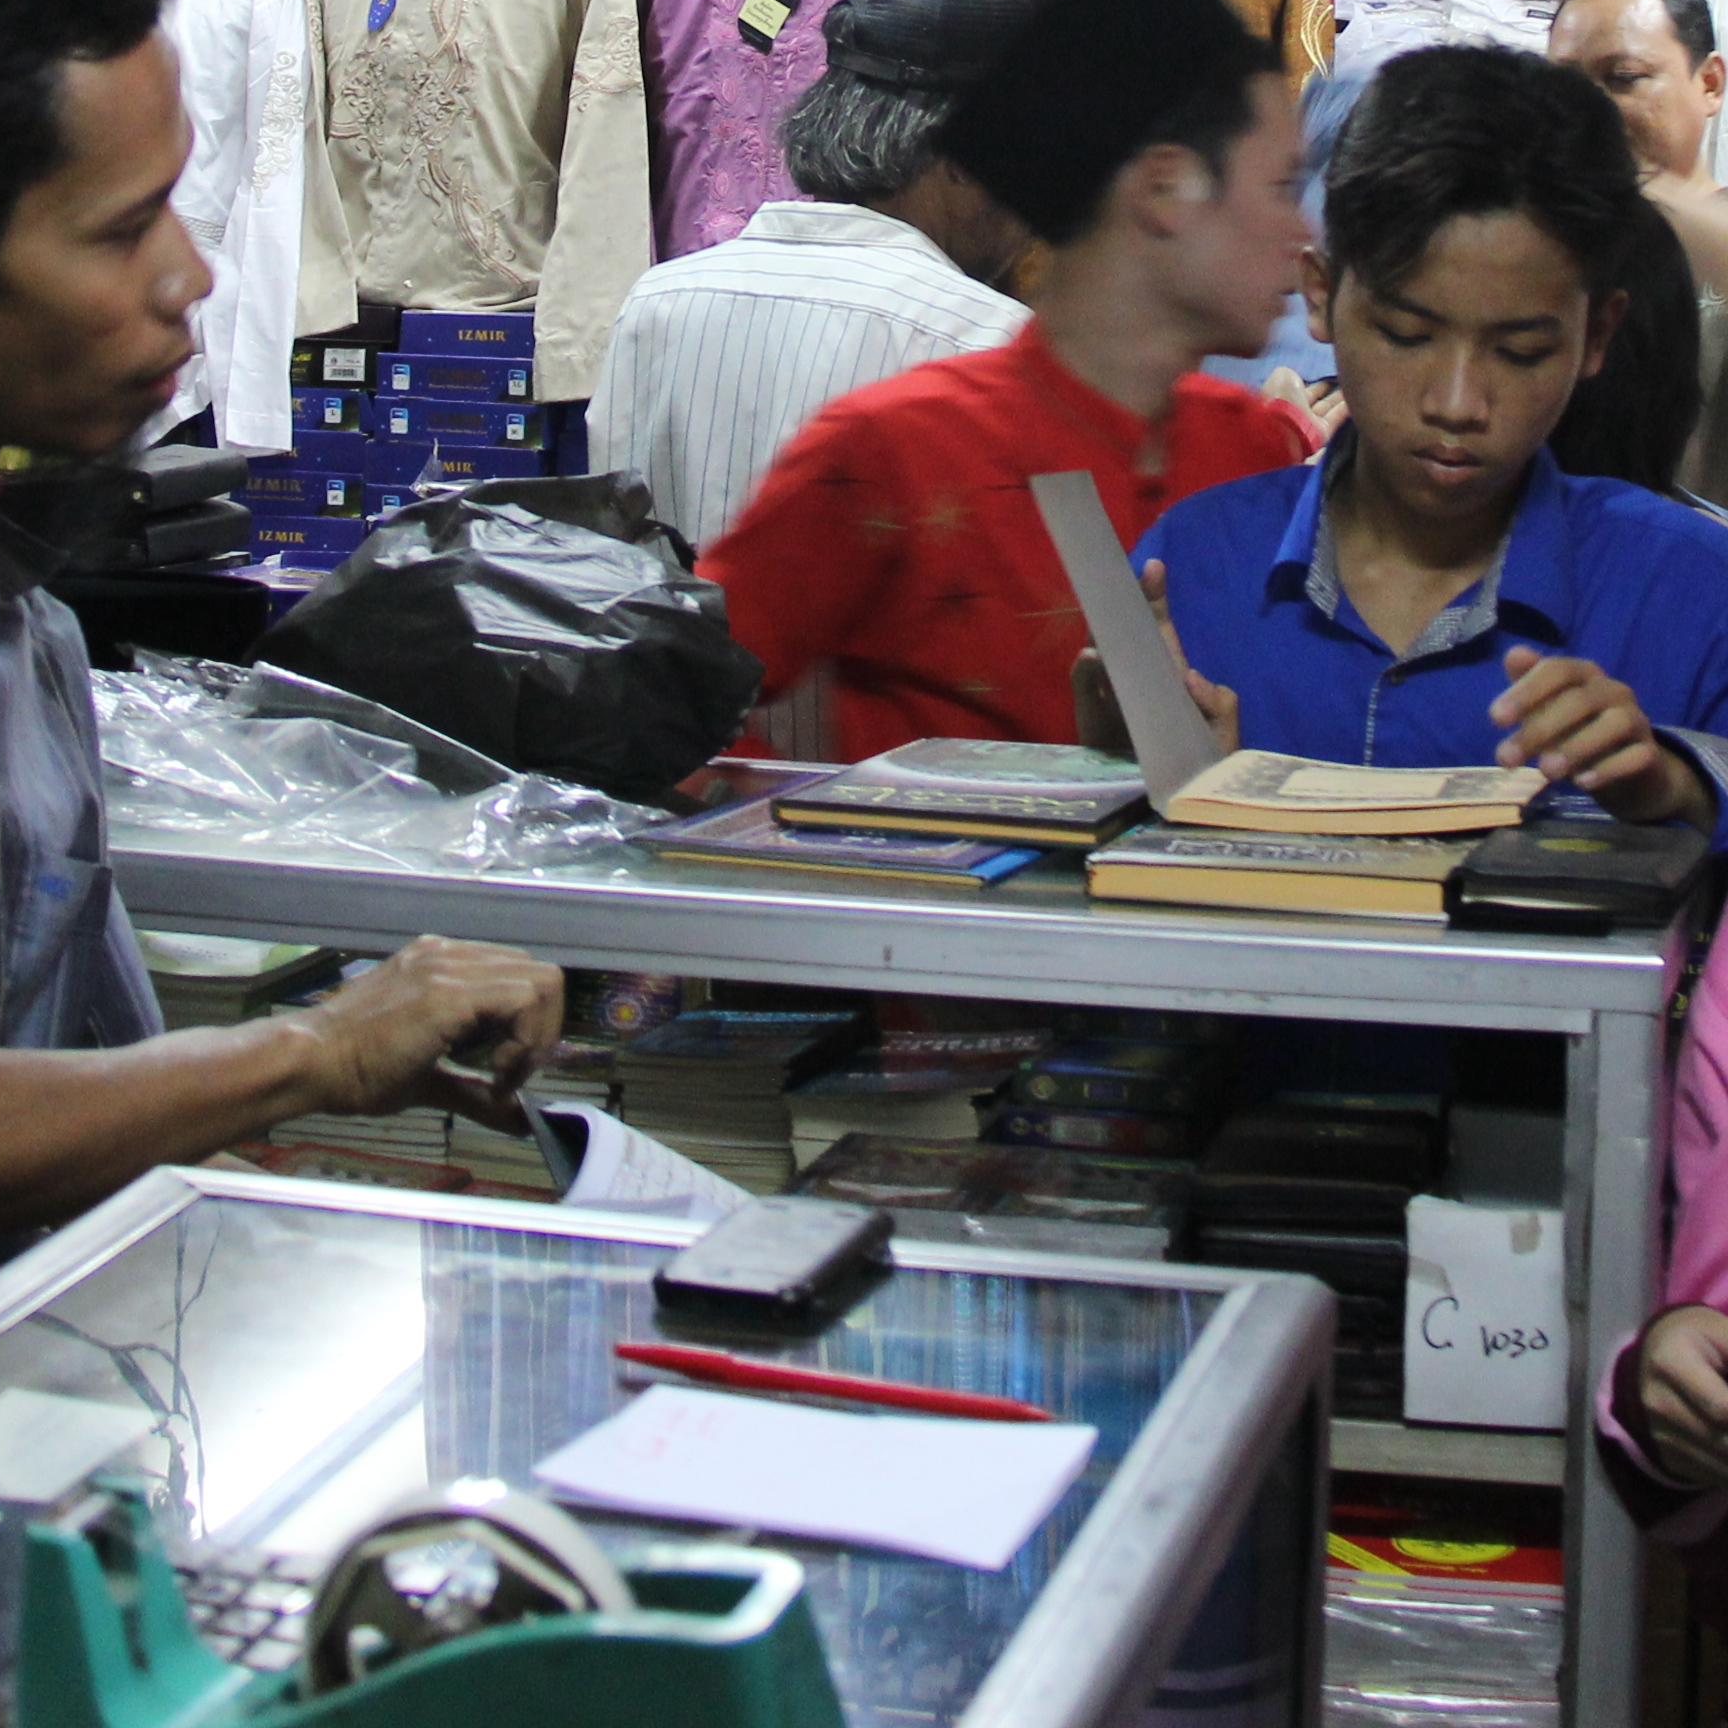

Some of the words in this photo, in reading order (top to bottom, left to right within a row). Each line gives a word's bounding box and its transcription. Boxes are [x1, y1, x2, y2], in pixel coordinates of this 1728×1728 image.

[457, 329, 507, 342] IZMIR
[442, 461, 473, 473] MIR
[258, 530, 306, 544] IZMIR
[1422, 1295, 1460, 1350] C
